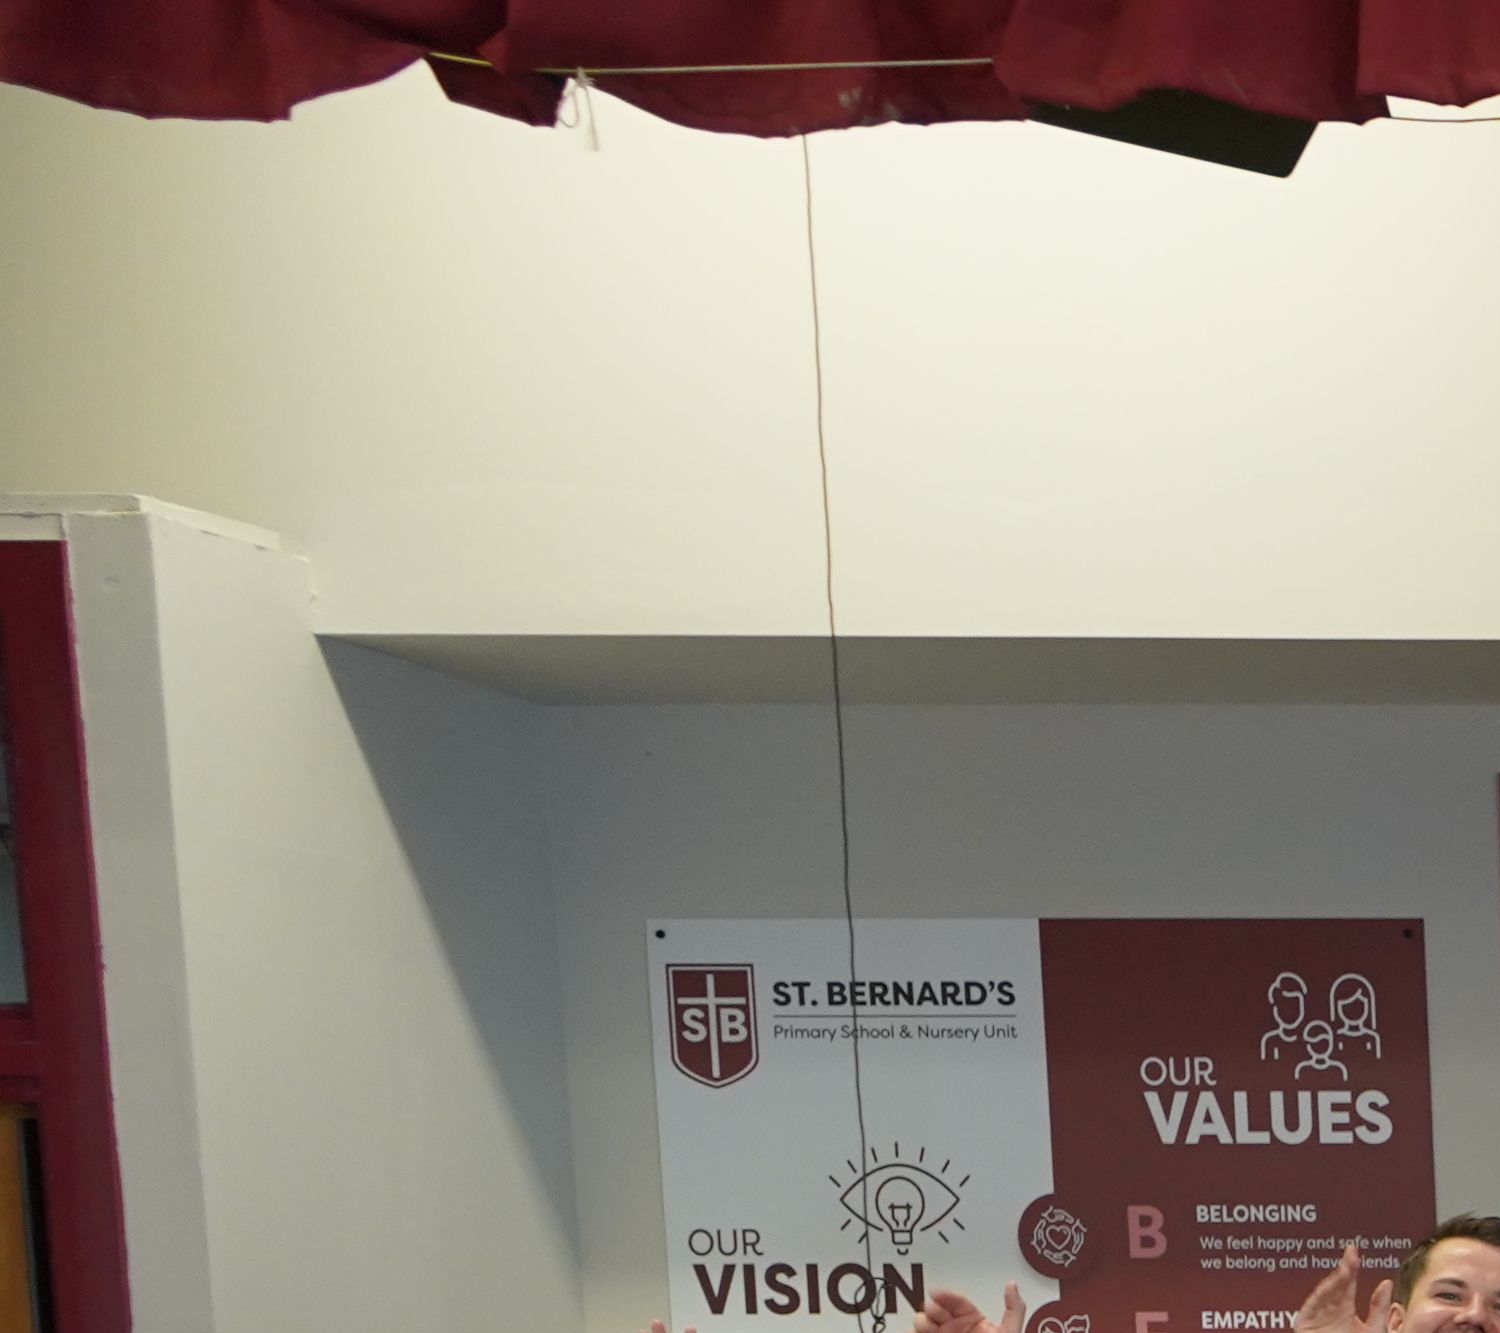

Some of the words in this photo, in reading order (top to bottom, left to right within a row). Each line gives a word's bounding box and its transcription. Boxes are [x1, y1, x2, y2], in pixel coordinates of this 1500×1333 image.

[772, 981, 819, 1007] ST.
[827, 980, 1017, 1007] BERNARD'S
[773, 1025, 837, 1042] Primary
[840, 1024, 896, 1039] School
[899, 1025, 913, 1039] &
[918, 1025, 980, 1042] Nursery
[984, 1024, 1019, 1039] Unit
[1140, 1056, 1217, 1086] OUR
[1143, 1089, 1394, 1145] VALUES
[1196, 1204, 1318, 1224] BELONGING
[688, 1229, 764, 1257] OUR
[1126, 1204, 1168, 1259] B
[1200, 1236, 1223, 1250] We
[1226, 1235, 1254, 1250] feel
[1257, 1235, 1303, 1253] happy
[1306, 1235, 1335, 1250] and
[1338, 1235, 1370, 1250] safe
[1373, 1235, 1412, 1250] when
[1200, 1258, 1222, 1270] we
[1225, 1255, 1276, 1273] belong
[1279, 1255, 1308, 1270] and
[692, 1262, 926, 1316] VISION
[1201, 1311, 1299, 1330] EMPATHY
